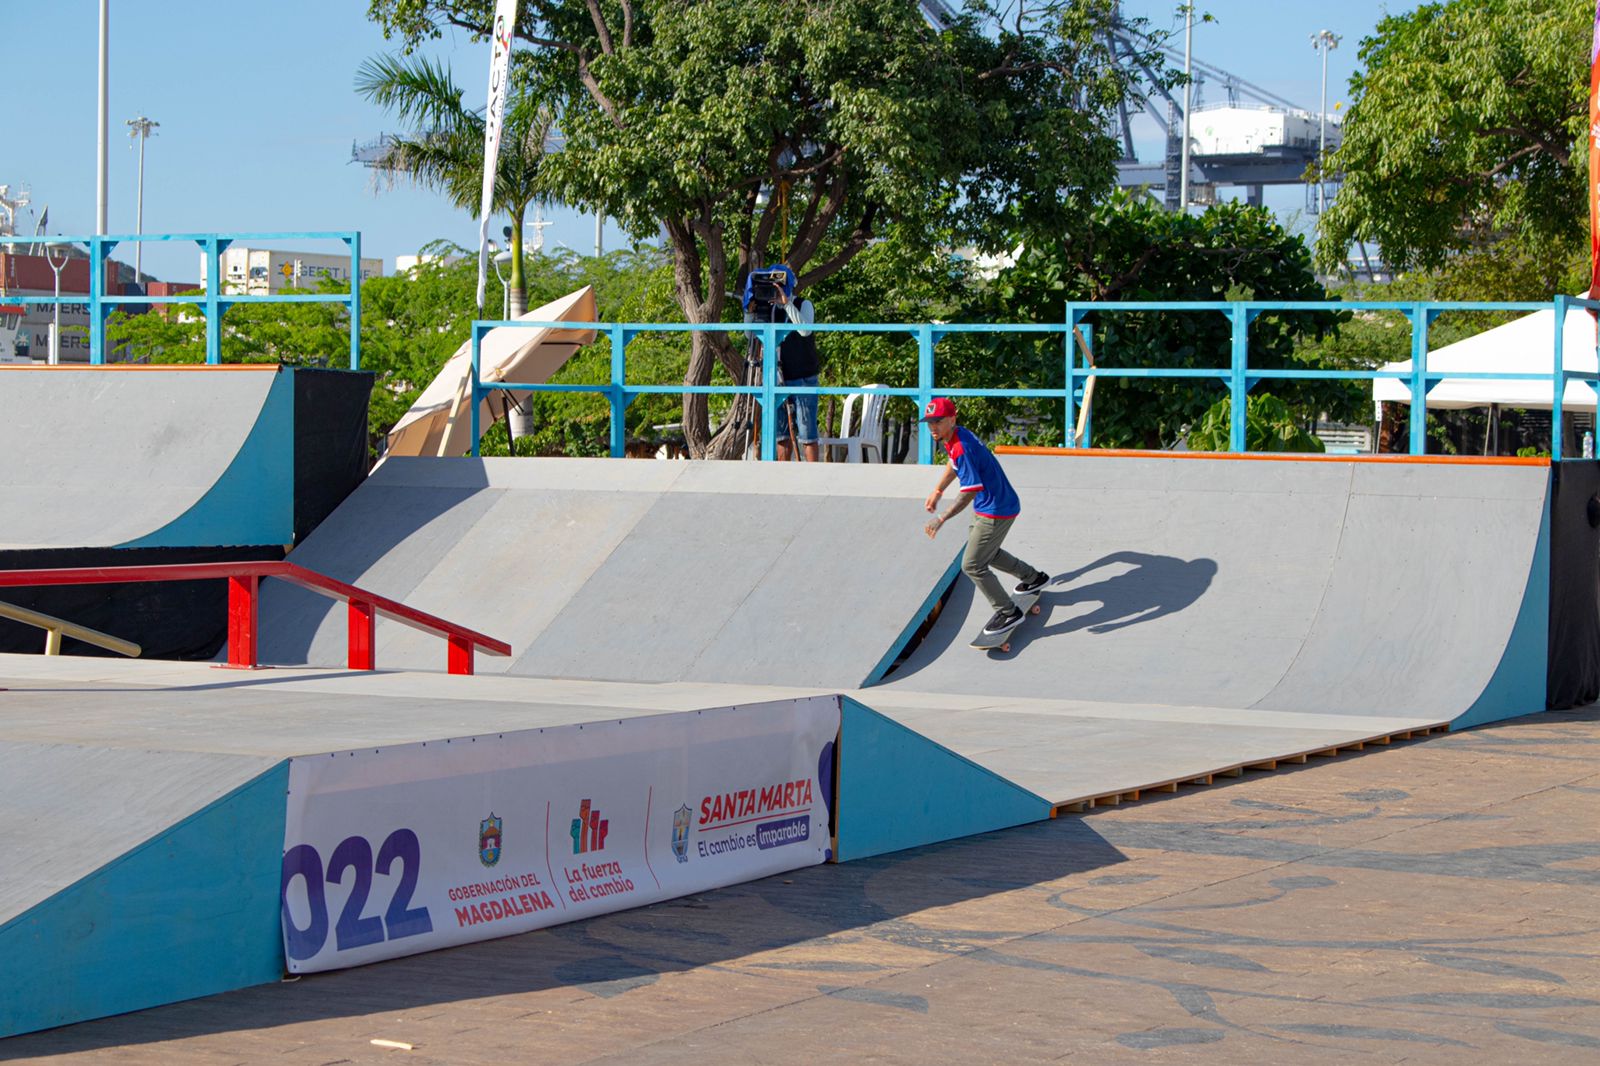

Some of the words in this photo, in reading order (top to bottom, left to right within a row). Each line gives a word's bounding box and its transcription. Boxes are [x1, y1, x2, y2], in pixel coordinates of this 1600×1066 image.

[699, 789, 757, 825] SANTA
[757, 778, 813, 813] MARTA
[697, 840, 708, 857] El
[709, 834, 745, 856] cambio
[746, 836, 757, 848] es
[758, 822, 807, 845] imparable
[448, 874, 520, 902] GOBERNACIÓN
[520, 872, 541, 888] DEL
[564, 866, 581, 884] La
[582, 860, 622, 881] fuerza
[281, 828, 433, 961] 022
[568, 885, 588, 903] del
[586, 877, 634, 898] cambio
[454, 890, 555, 928] MAGDALENA
